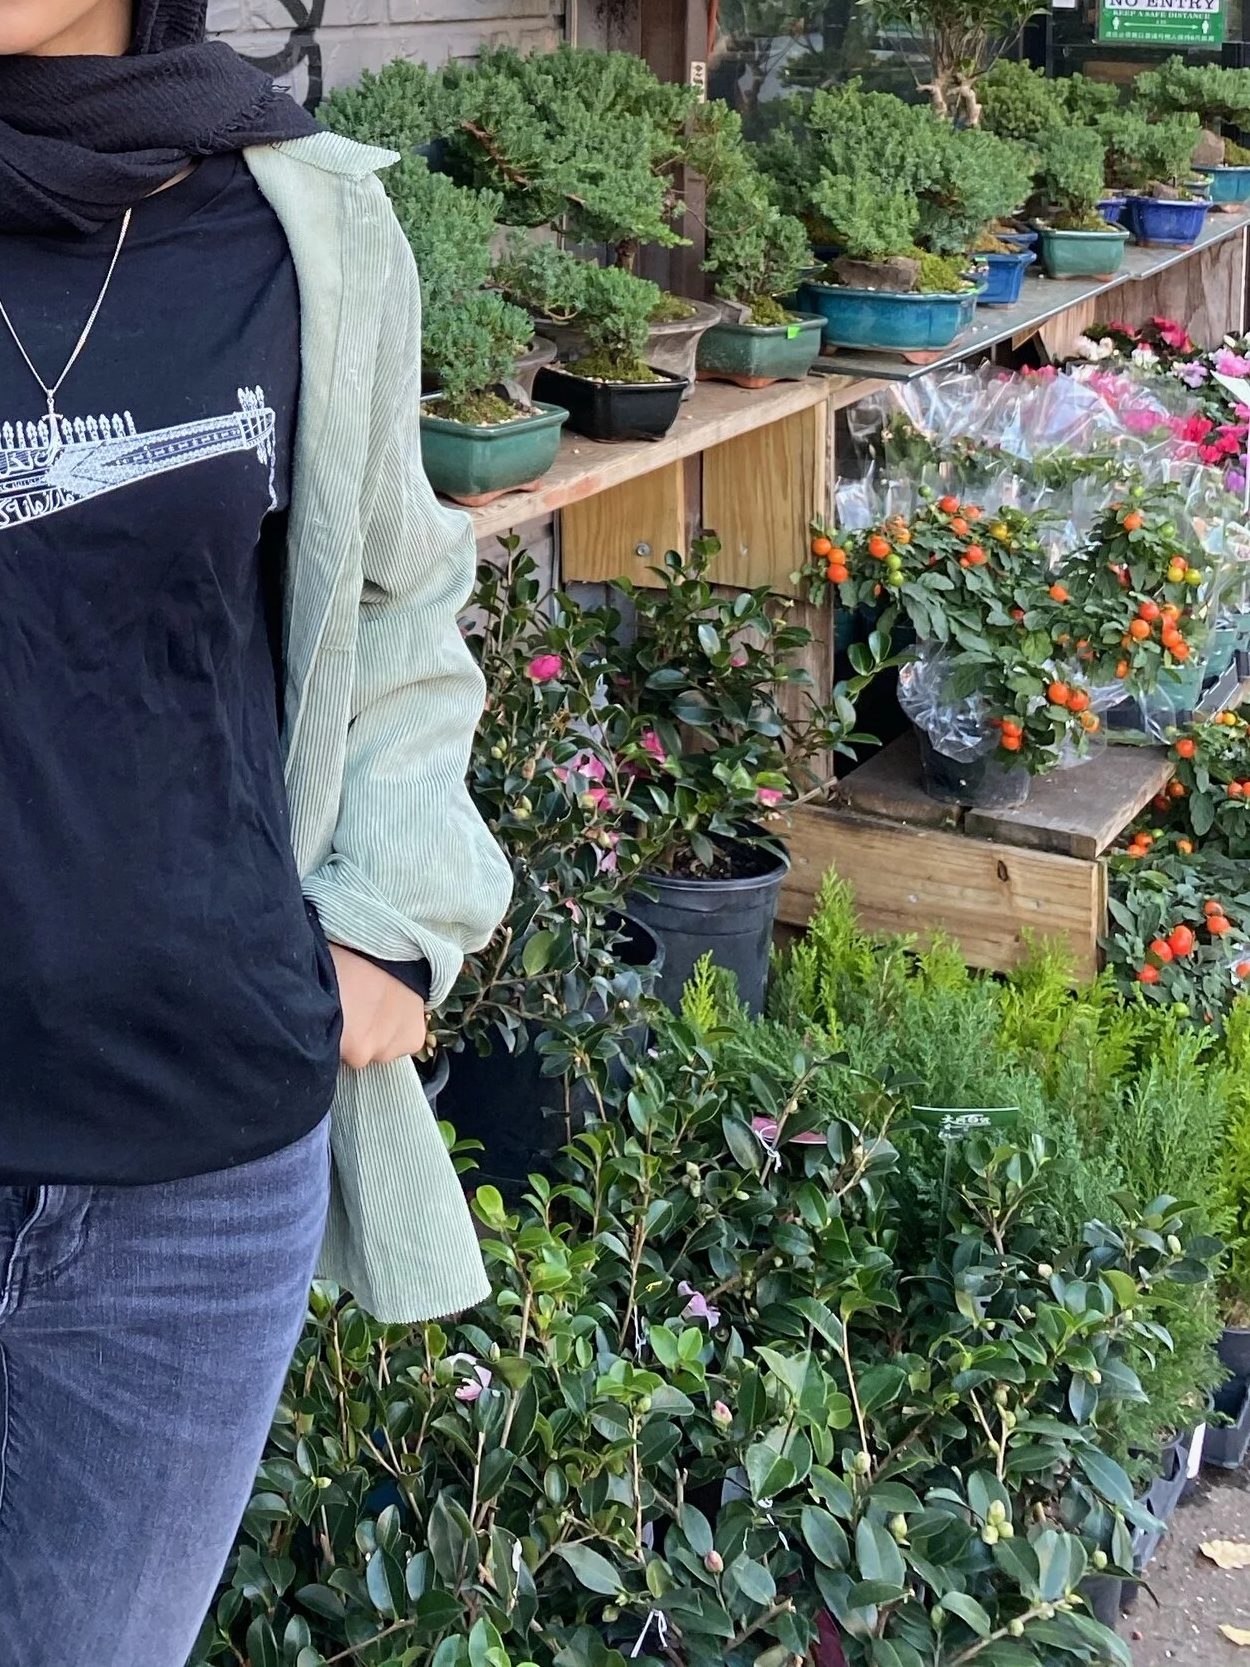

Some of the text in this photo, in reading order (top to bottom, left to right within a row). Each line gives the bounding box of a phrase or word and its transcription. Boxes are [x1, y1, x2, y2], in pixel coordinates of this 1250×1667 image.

[1113, 10, 1136, 18] KEEP
[1144, 11, 1167, 19] SAFE
[1168, 12, 1210, 21] DISTANCE
